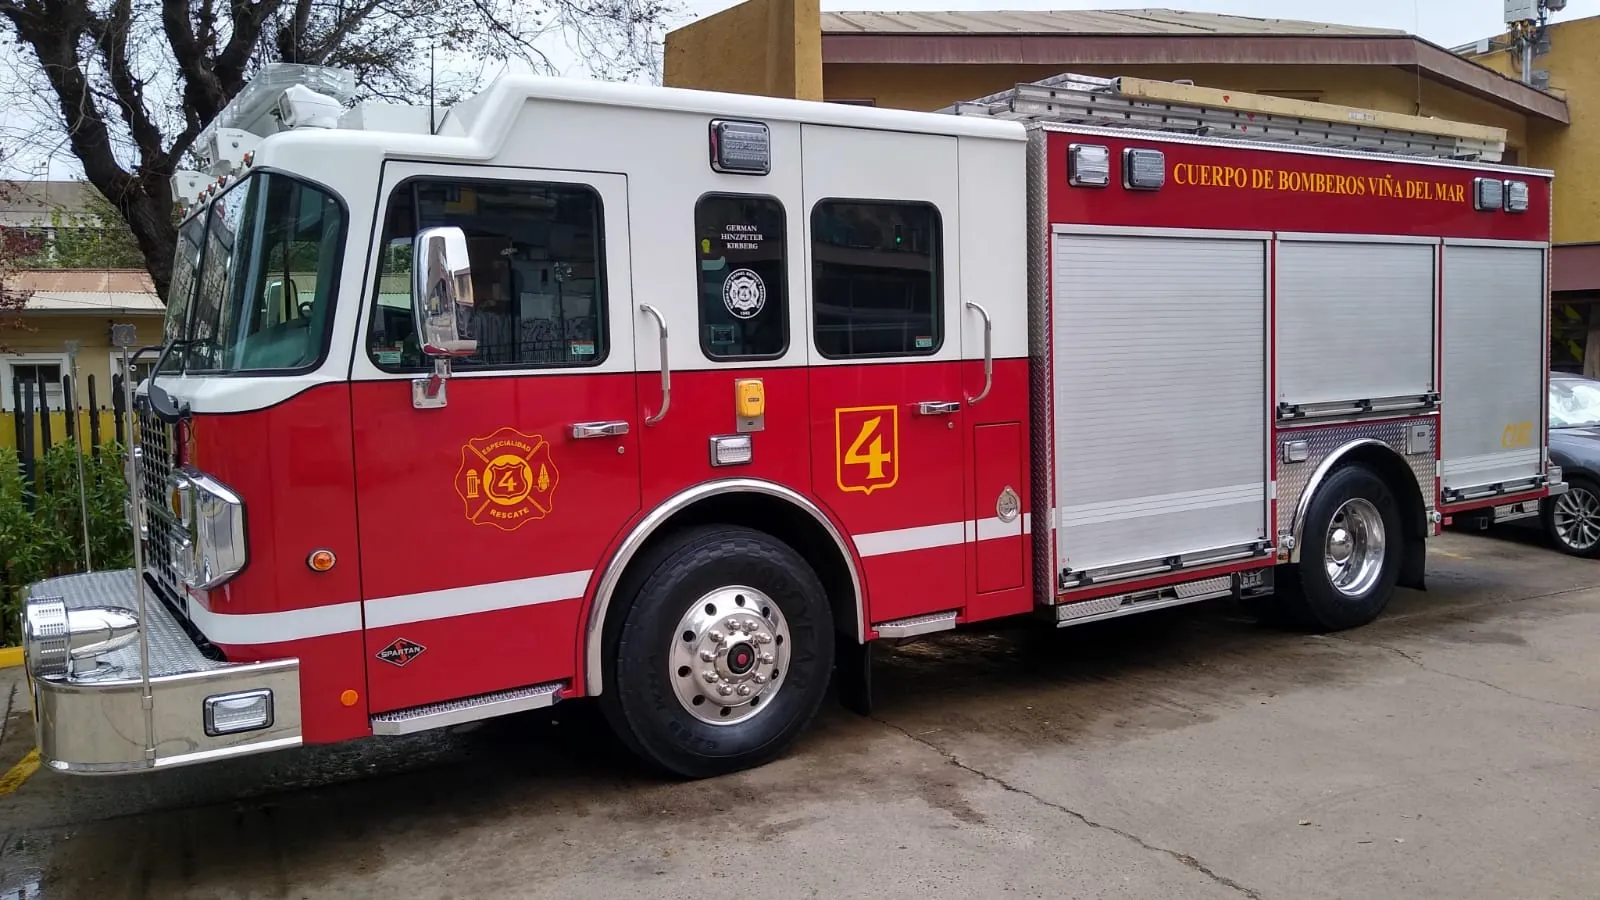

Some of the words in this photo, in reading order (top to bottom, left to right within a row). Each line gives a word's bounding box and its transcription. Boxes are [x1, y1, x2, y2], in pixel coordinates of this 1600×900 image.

[1173, 162, 1248, 188] CUERPO
[1252, 169, 1273, 190] DE
[1278, 171, 1365, 196] BOMBEROS
[1368, 174, 1404, 198] VIÑA
[1405, 180, 1432, 200] DEL
[1435, 182, 1465, 202] MAR
[721, 233, 763, 241] HINZPETER
[481, 440, 532, 455] ESPECIALIDAD
[844, 415, 891, 480] 4
[498, 470, 517, 492] 4
[490, 507, 530, 519] RESCATE
[381, 647, 420, 657] SPARTAN
